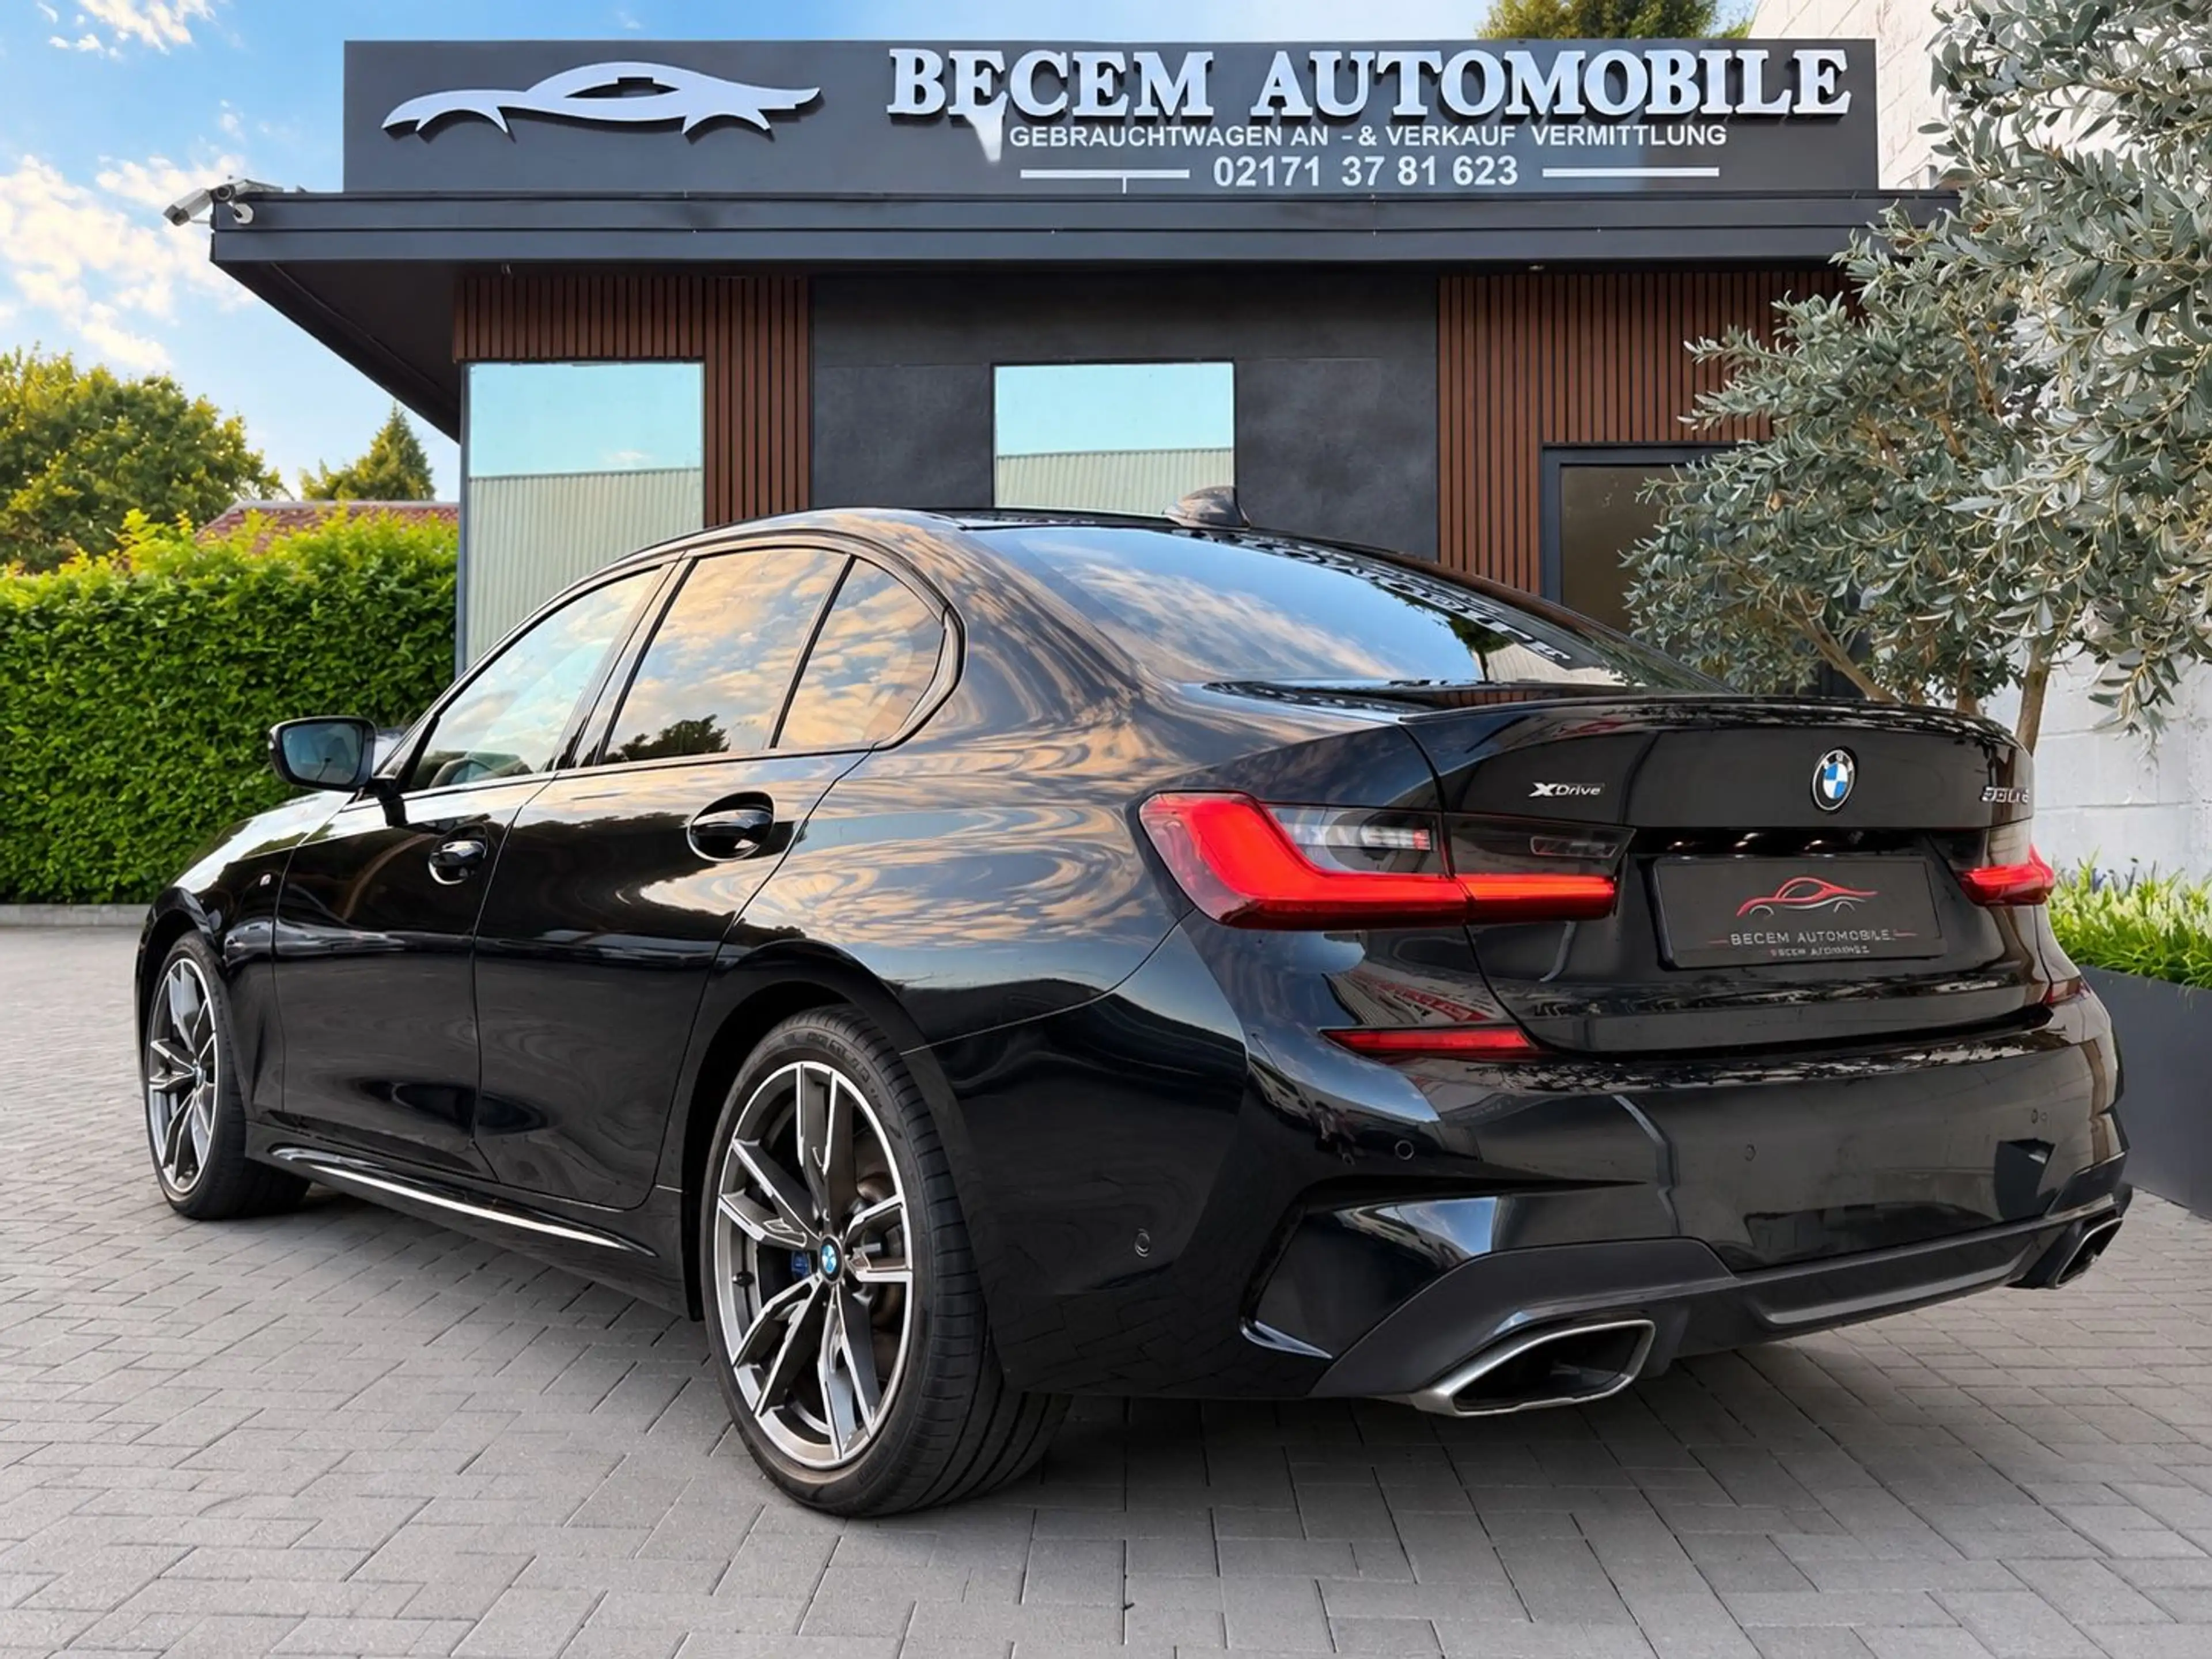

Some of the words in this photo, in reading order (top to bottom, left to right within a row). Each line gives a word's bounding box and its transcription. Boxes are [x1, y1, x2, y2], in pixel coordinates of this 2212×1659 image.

[886, 48, 1215, 117] BECEM
[1249, 48, 1851, 116] AUTOMOBILE
[1009, 125, 1282, 147] GEBRAUCHTWAGEN
[1290, 125, 1328, 147] AN
[1385, 124, 1516, 147] VERKAUF
[1530, 124, 1727, 146] VERMITTLUNG
[1213, 155, 1319, 187] 02171
[1341, 155, 1385, 187] 37
[1397, 155, 1435, 186] 81
[1452, 154, 1518, 186] 623
[1730, 931, 1790, 946] BECEM
